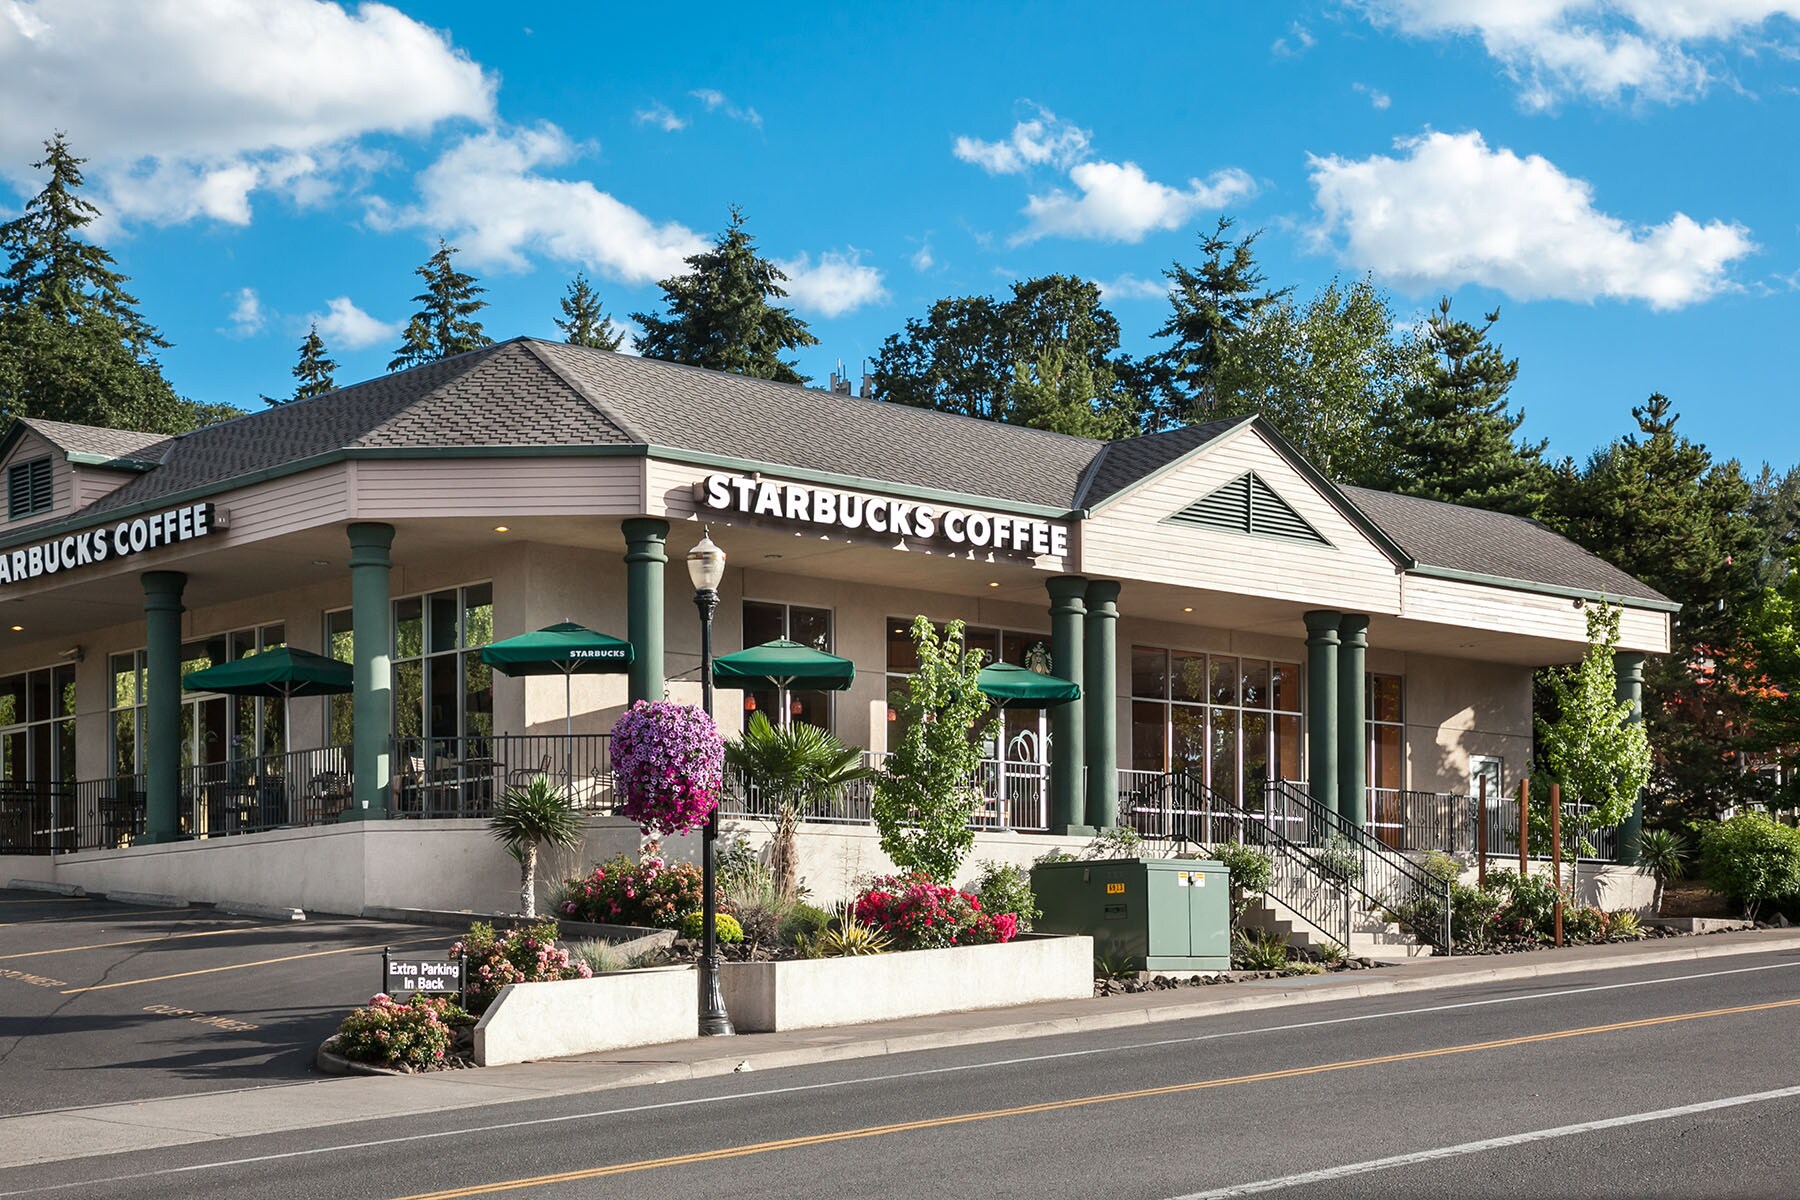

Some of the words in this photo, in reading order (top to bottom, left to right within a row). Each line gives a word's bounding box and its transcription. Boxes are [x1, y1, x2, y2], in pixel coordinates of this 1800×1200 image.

[114, 503, 208, 556] COFFEE
[707, 473, 935, 538] STARBUCKS
[943, 509, 1068, 557] COFFEE
[389, 962, 418, 975] Extra
[421, 963, 459, 978] Parking
[404, 977, 414, 989] In
[417, 977, 444, 989] Back
